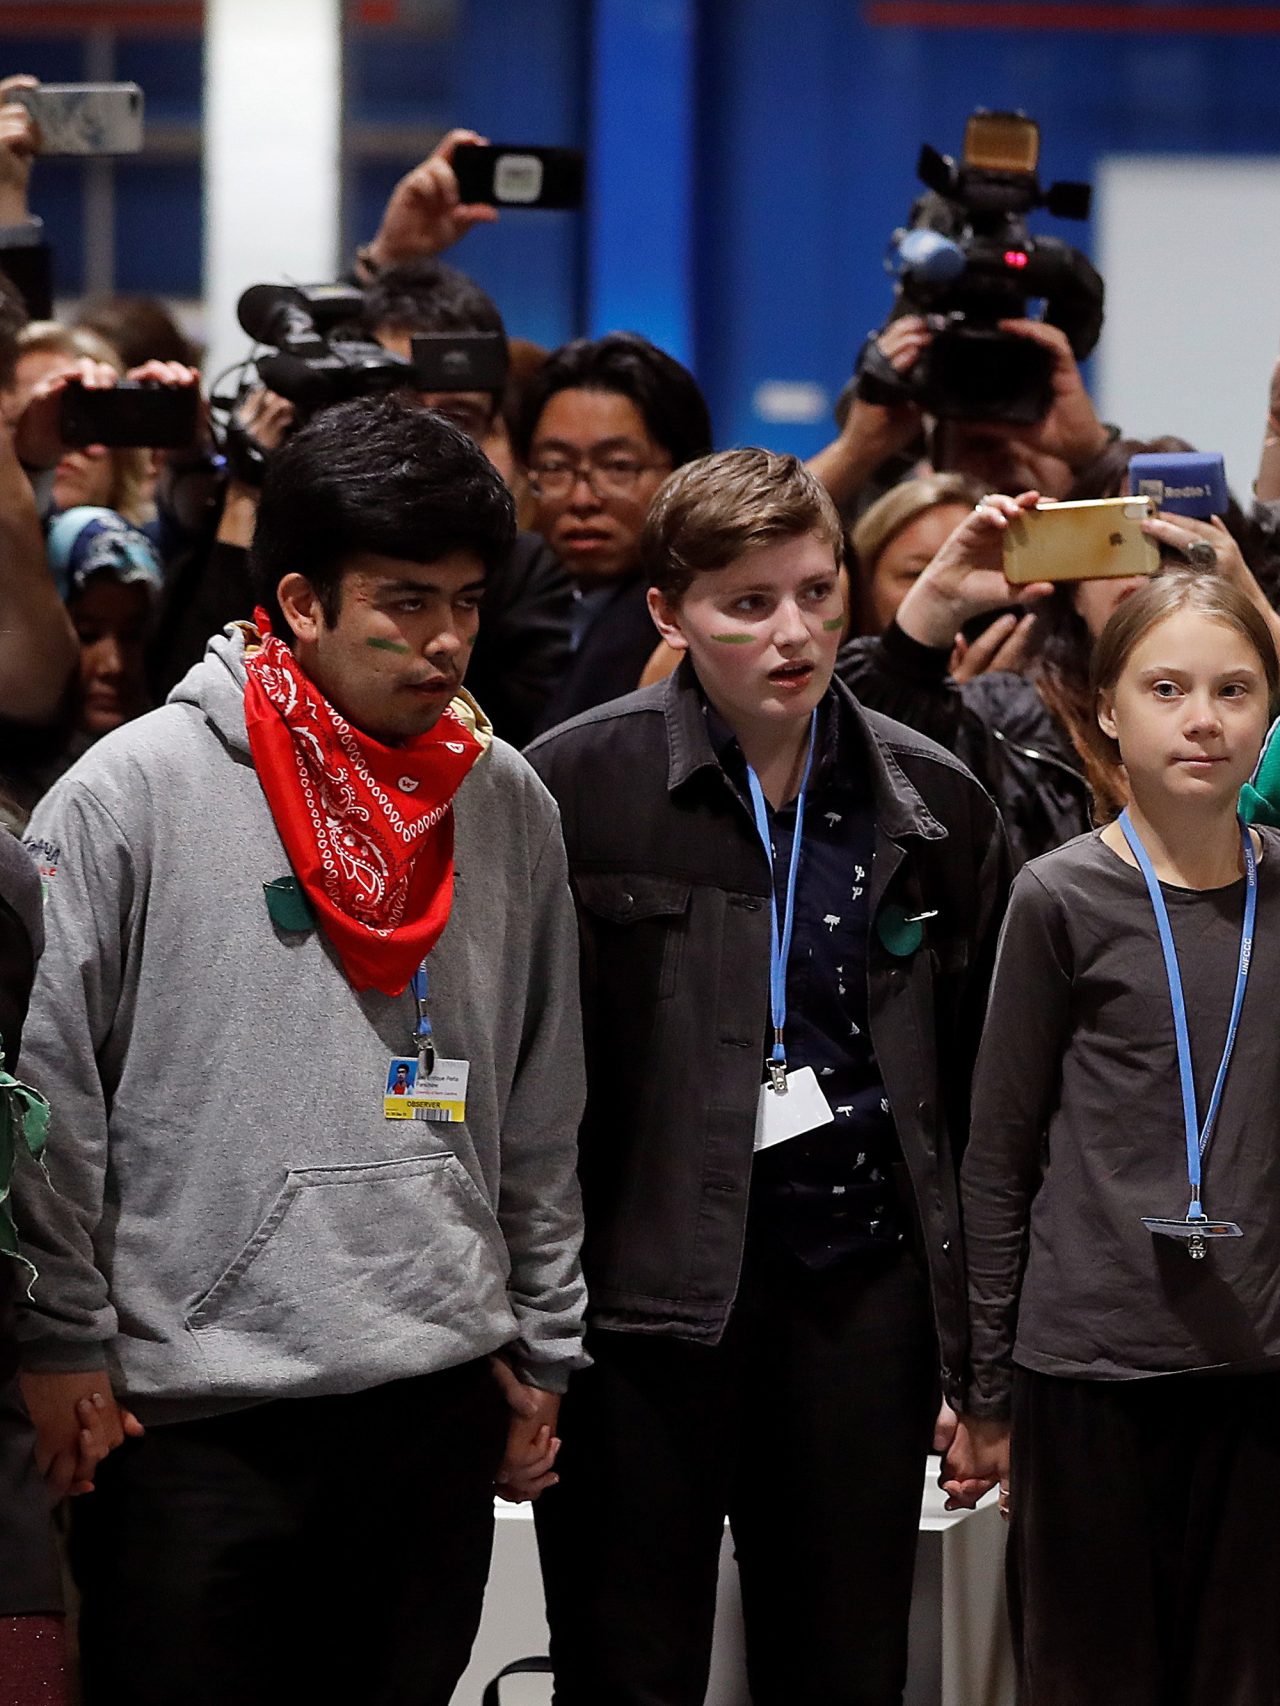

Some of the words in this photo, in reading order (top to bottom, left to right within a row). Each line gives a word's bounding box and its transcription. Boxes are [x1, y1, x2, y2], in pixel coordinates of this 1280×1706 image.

[1245, 848, 1255, 886] unfccc.int
[1241, 938, 1252, 976] UNFCCC
[407, 1100, 441, 1109] OBSERVER
